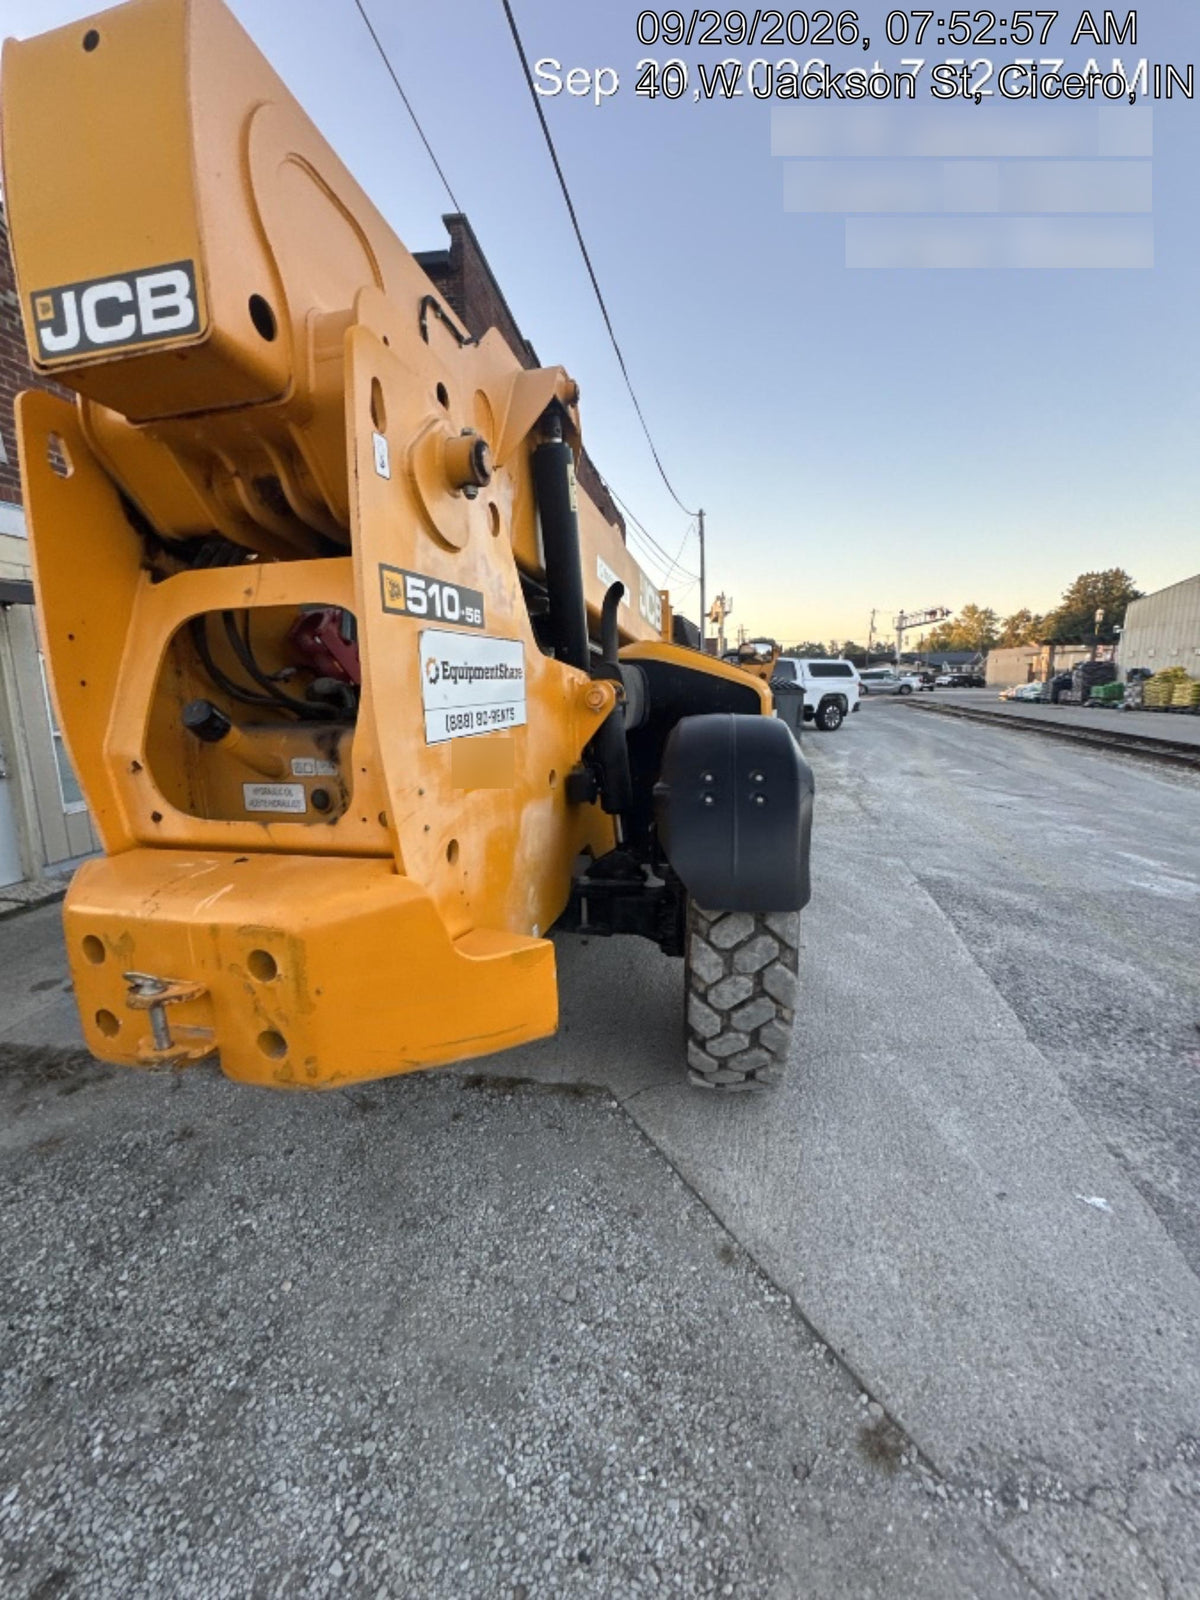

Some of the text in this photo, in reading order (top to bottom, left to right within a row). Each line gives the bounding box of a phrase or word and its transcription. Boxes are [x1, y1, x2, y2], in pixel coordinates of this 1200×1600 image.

[40, 269, 195, 352] JCB
[441, 660, 523, 685] EquipmentShare
[445, 710, 474, 733] (888)
